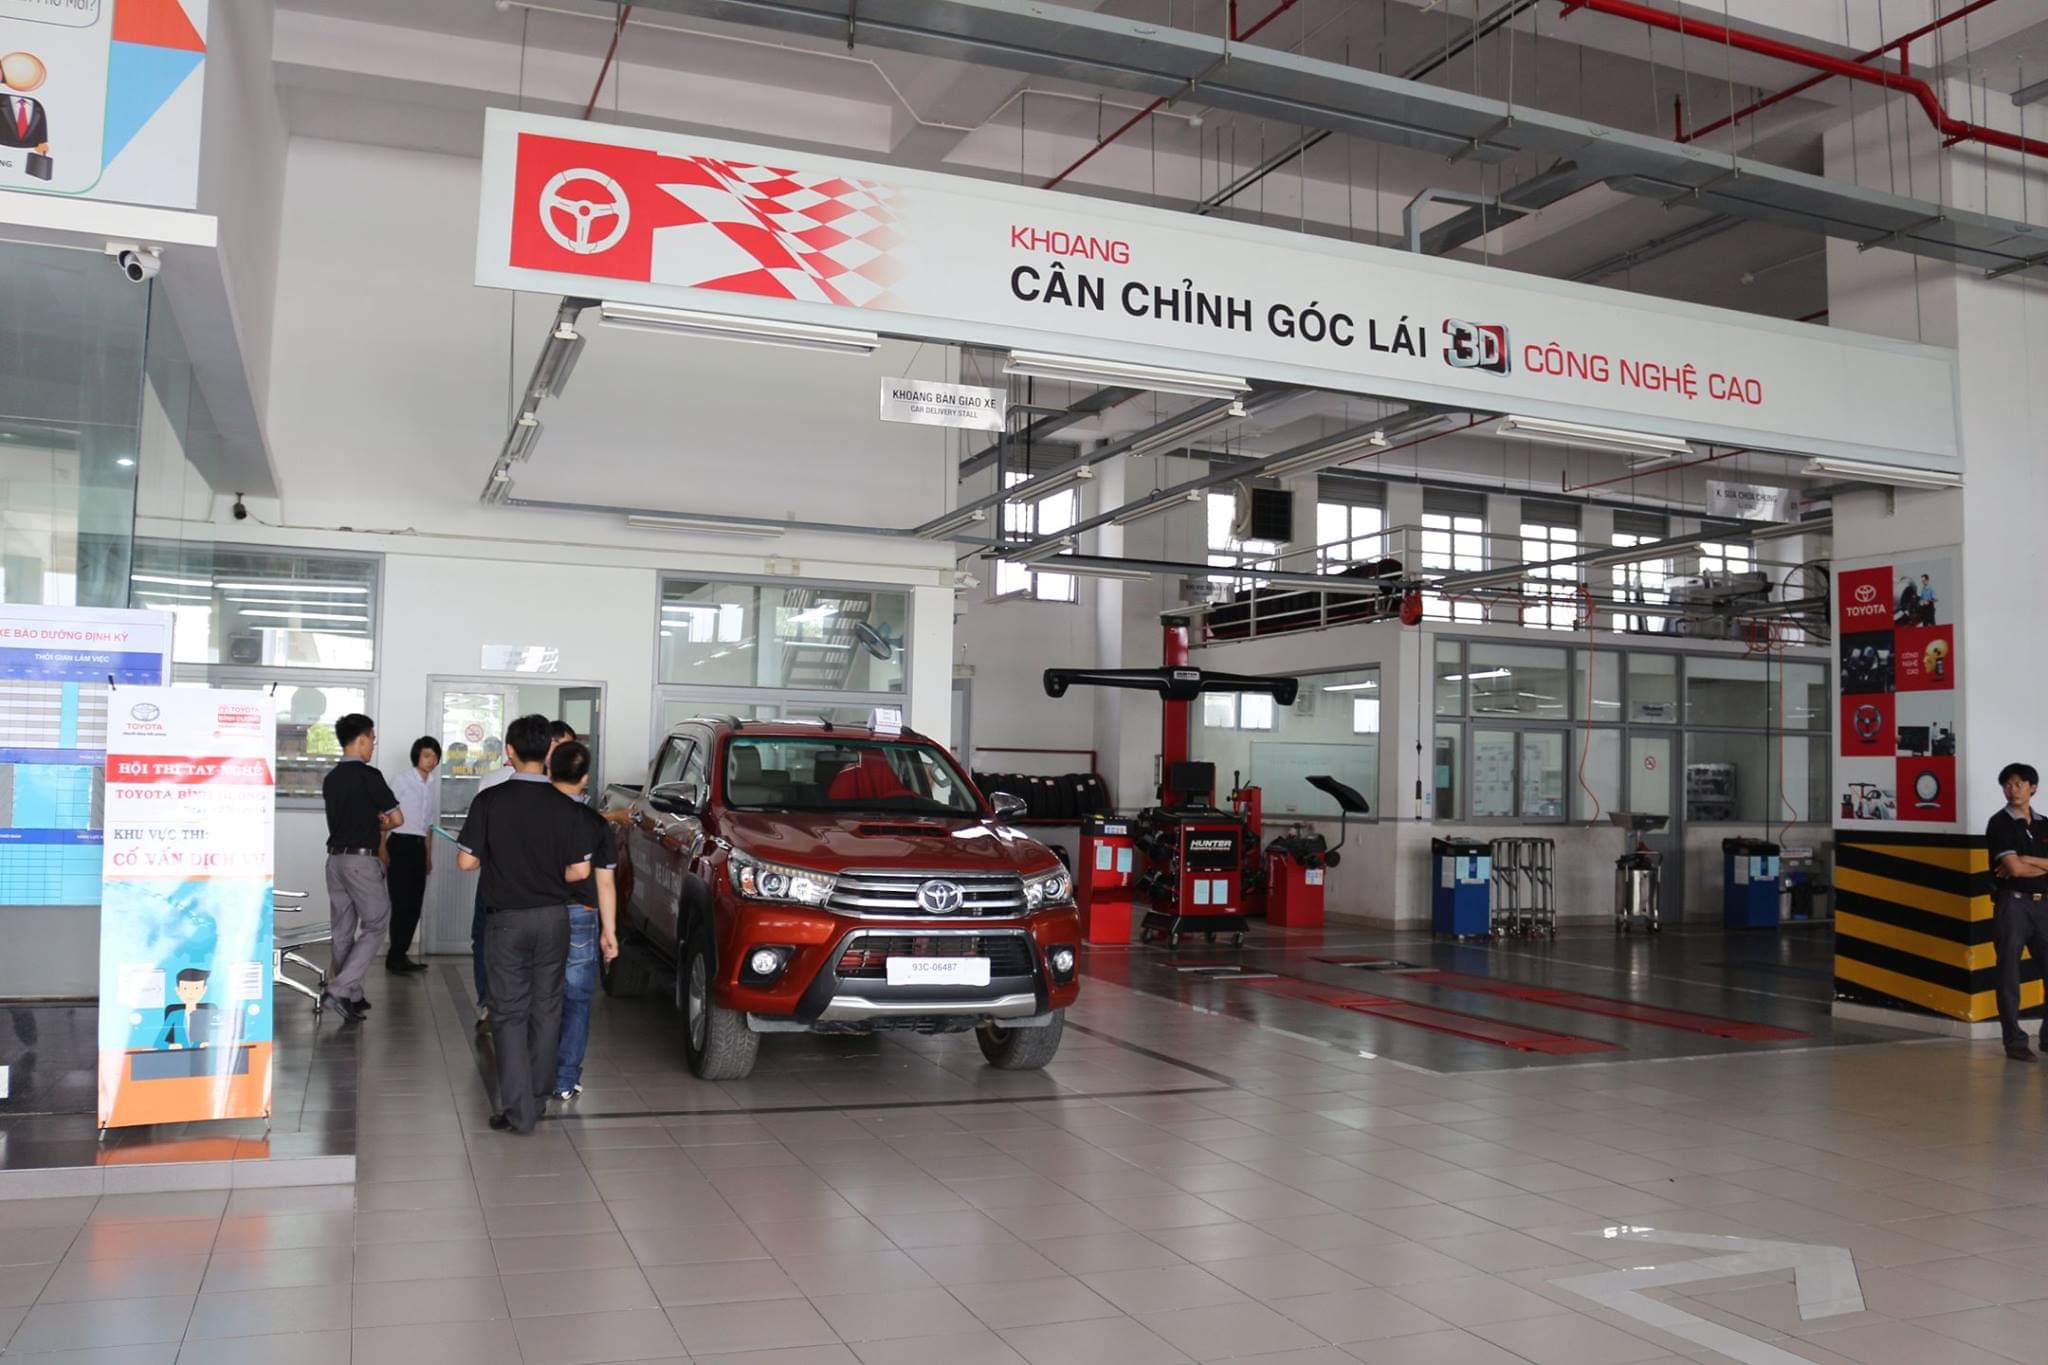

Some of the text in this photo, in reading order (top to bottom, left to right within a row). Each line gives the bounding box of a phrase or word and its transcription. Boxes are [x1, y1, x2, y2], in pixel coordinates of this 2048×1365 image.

[1011, 225, 1130, 265] KHOANG
[1011, 261, 1762, 405] CÂN CHỈNH GÓC LÁI 3D CÔNG NGHỆ CAO
[892, 389, 933, 402] KHOANG
[959, 395, 981, 408] GIAO
[984, 398, 997, 409] XE
[910, 405, 978, 418] CAR DELIVERY STALL
[1846, 604, 1887, 617] TOYOTA
[126, 722, 163, 731] TOYOTA
[118, 761, 149, 776] HỘI
[187, 763, 217, 777] TAY
[116, 789, 173, 800] TOYOTA
[113, 829, 145, 840] KHU
[149, 827, 177, 843] VỰC
[1190, 840, 1233, 850] HUNTER
[113, 846, 140, 867] CỐ
